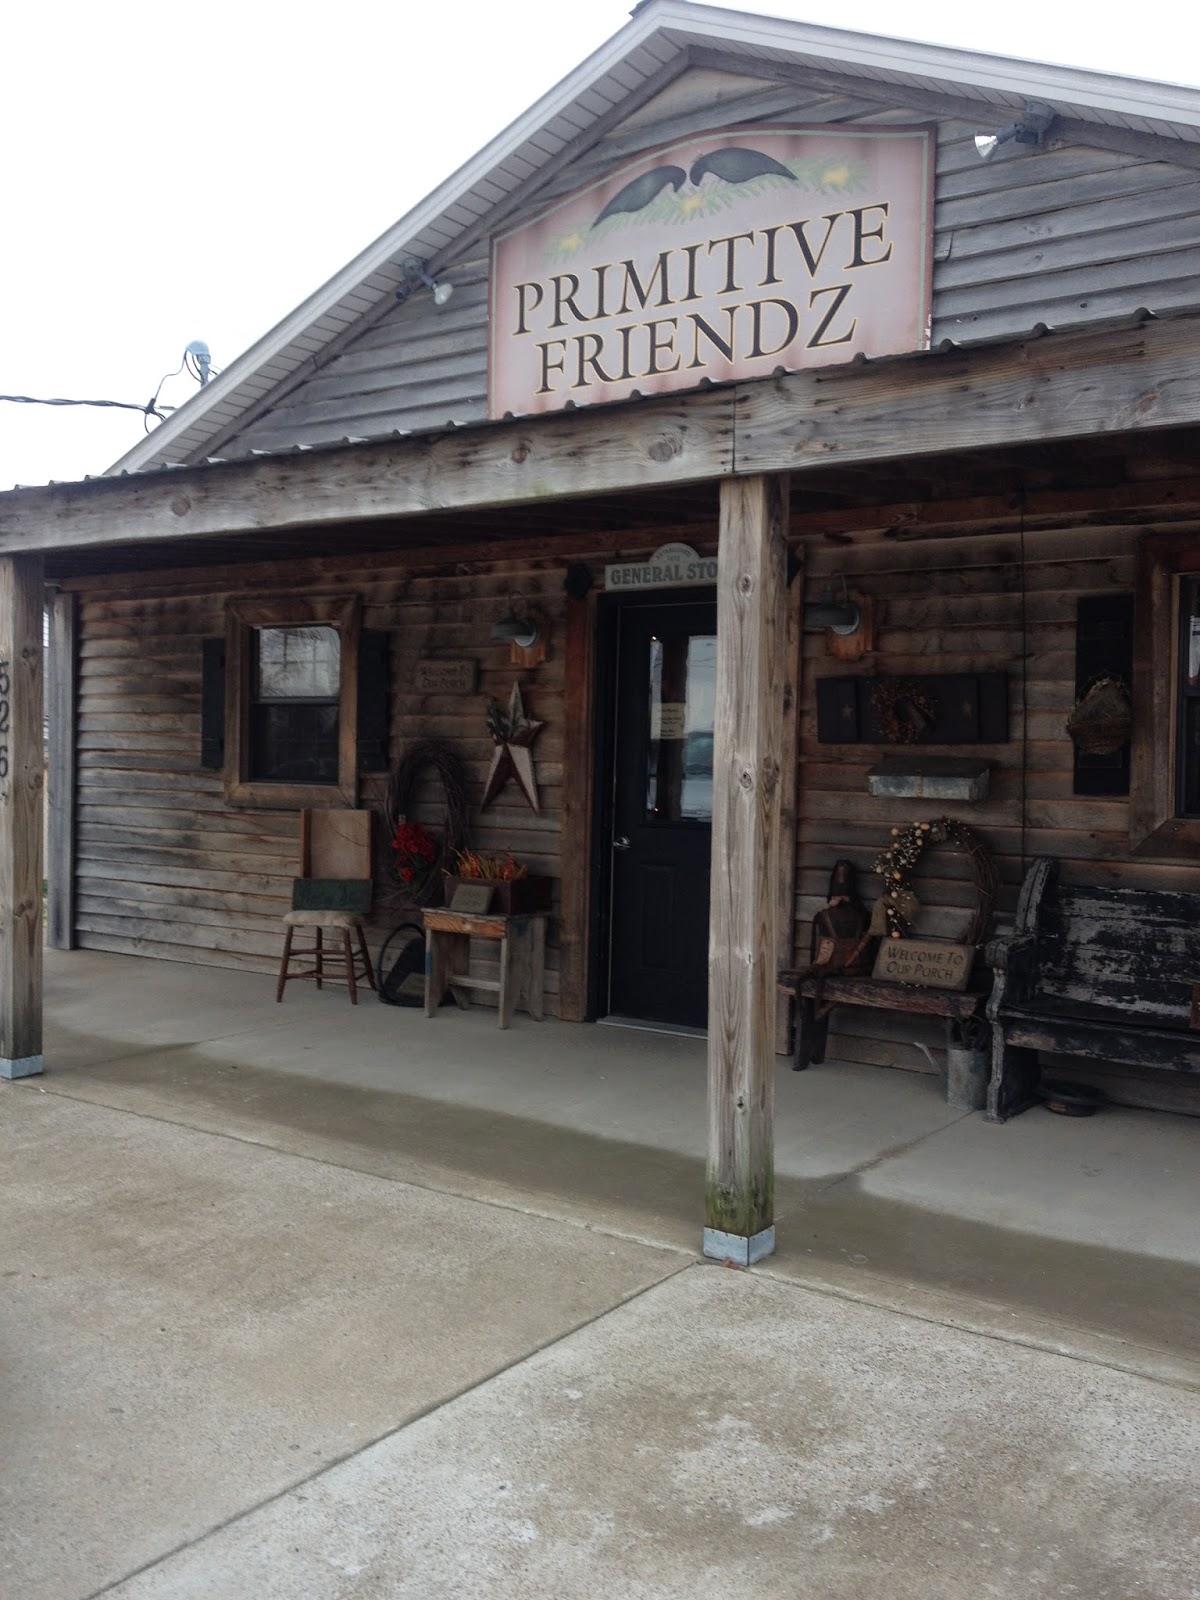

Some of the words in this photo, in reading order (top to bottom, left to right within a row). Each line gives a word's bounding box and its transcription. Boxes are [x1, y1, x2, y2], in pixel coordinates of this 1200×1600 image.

[512, 202, 893, 336] PRIMITIVE
[534, 283, 858, 395] FRIENDZ
[611, 564, 683, 585] GENERAL
[888, 946, 944, 963] WELCOME
[948, 951, 963, 965] TO
[886, 961, 912, 974] OUR
[915, 964, 954, 979] PORCH
